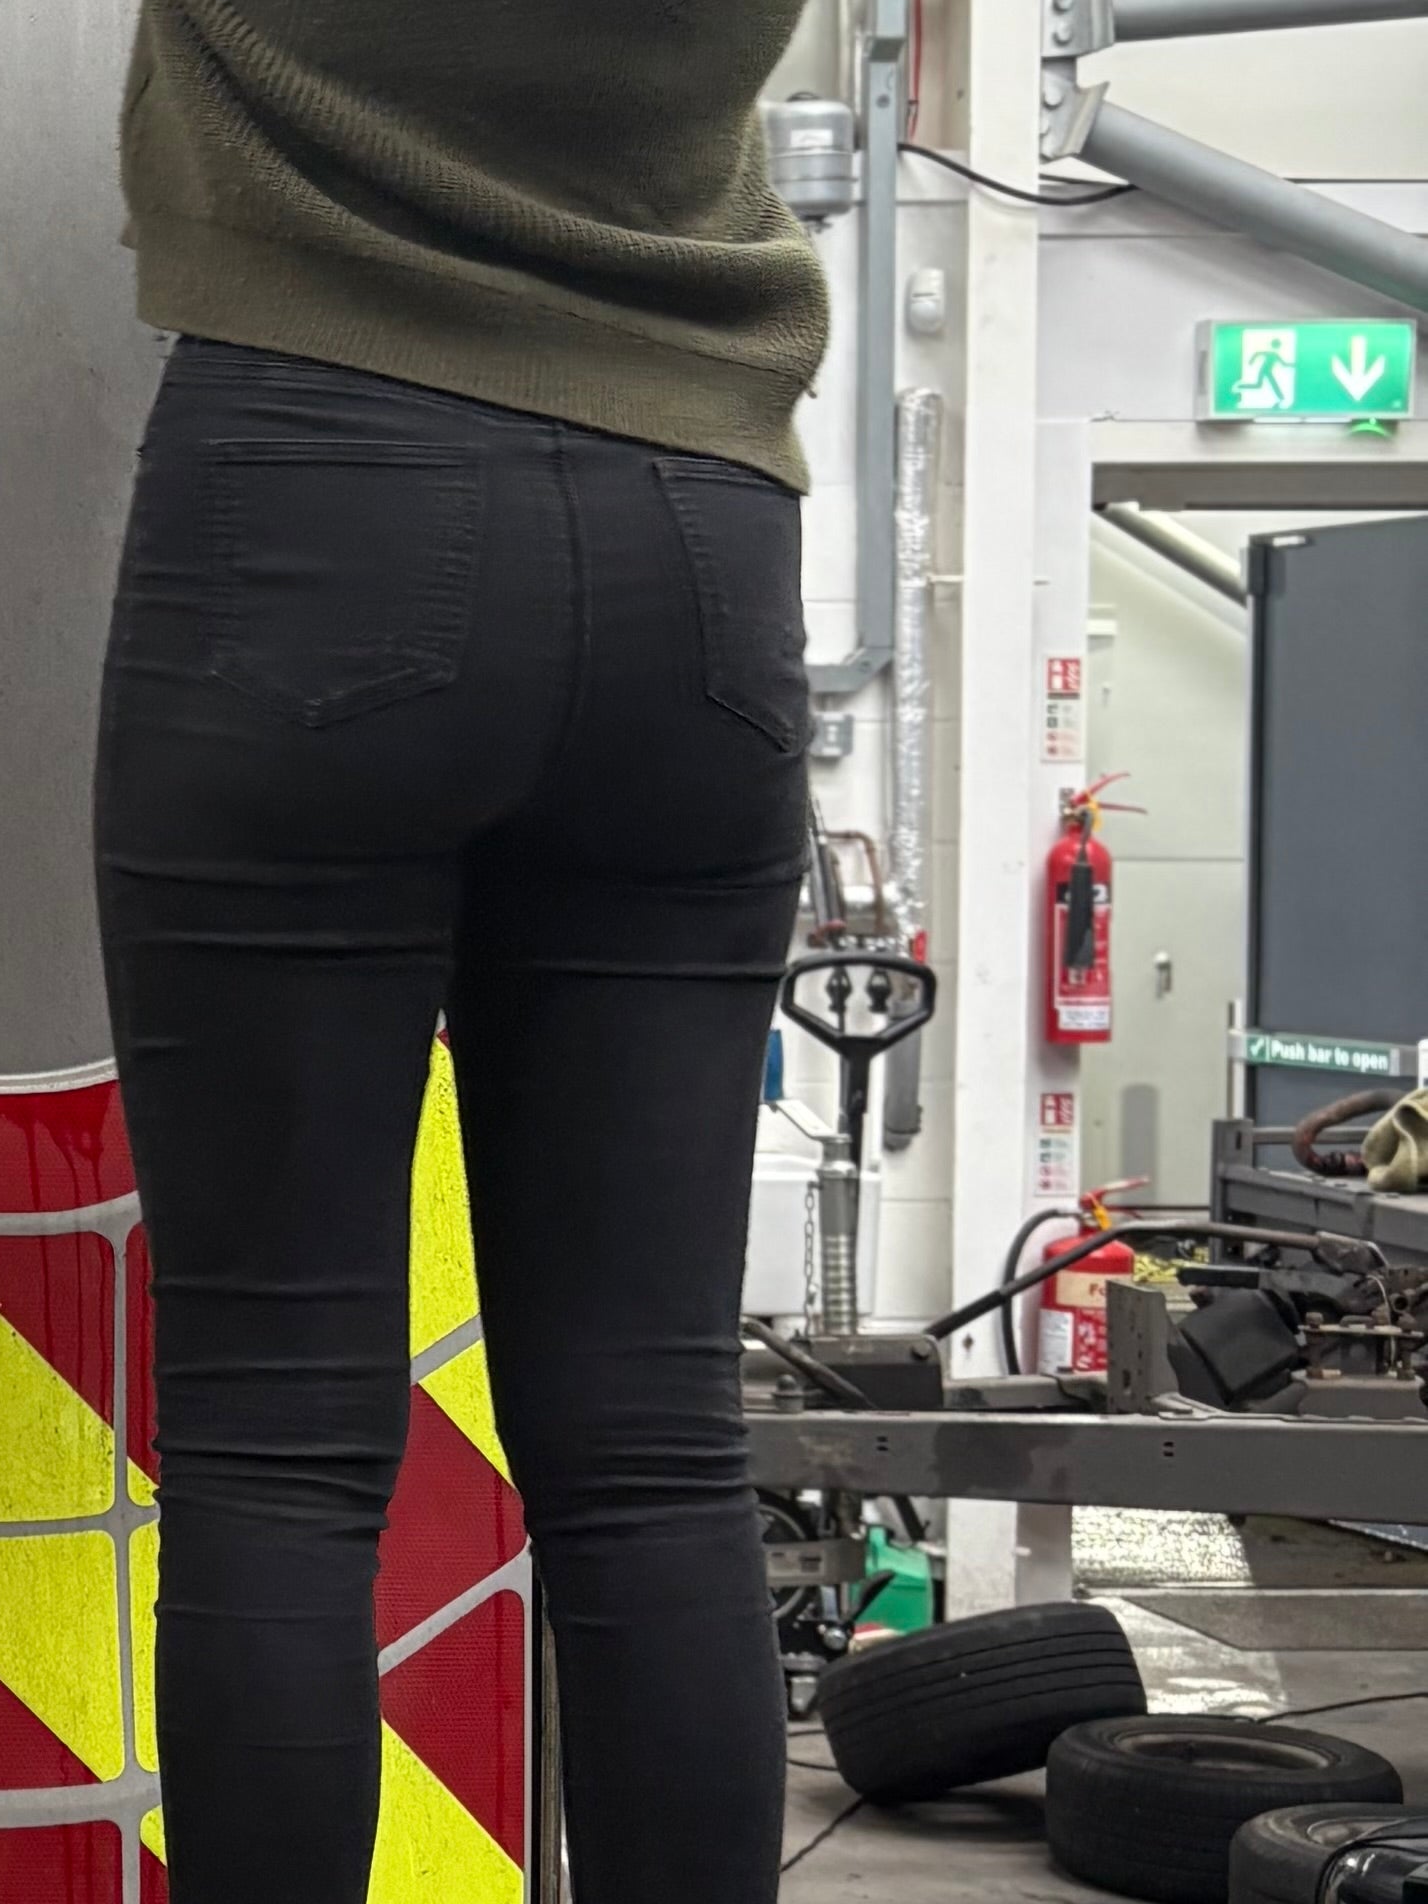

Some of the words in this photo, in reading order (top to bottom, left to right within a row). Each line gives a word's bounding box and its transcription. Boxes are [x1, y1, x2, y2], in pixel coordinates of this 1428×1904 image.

[1271, 1039, 1305, 1061] Push
[1308, 1044, 1331, 1064] bar
[1334, 1047, 1349, 1066] to
[1352, 1052, 1388, 1073] open
